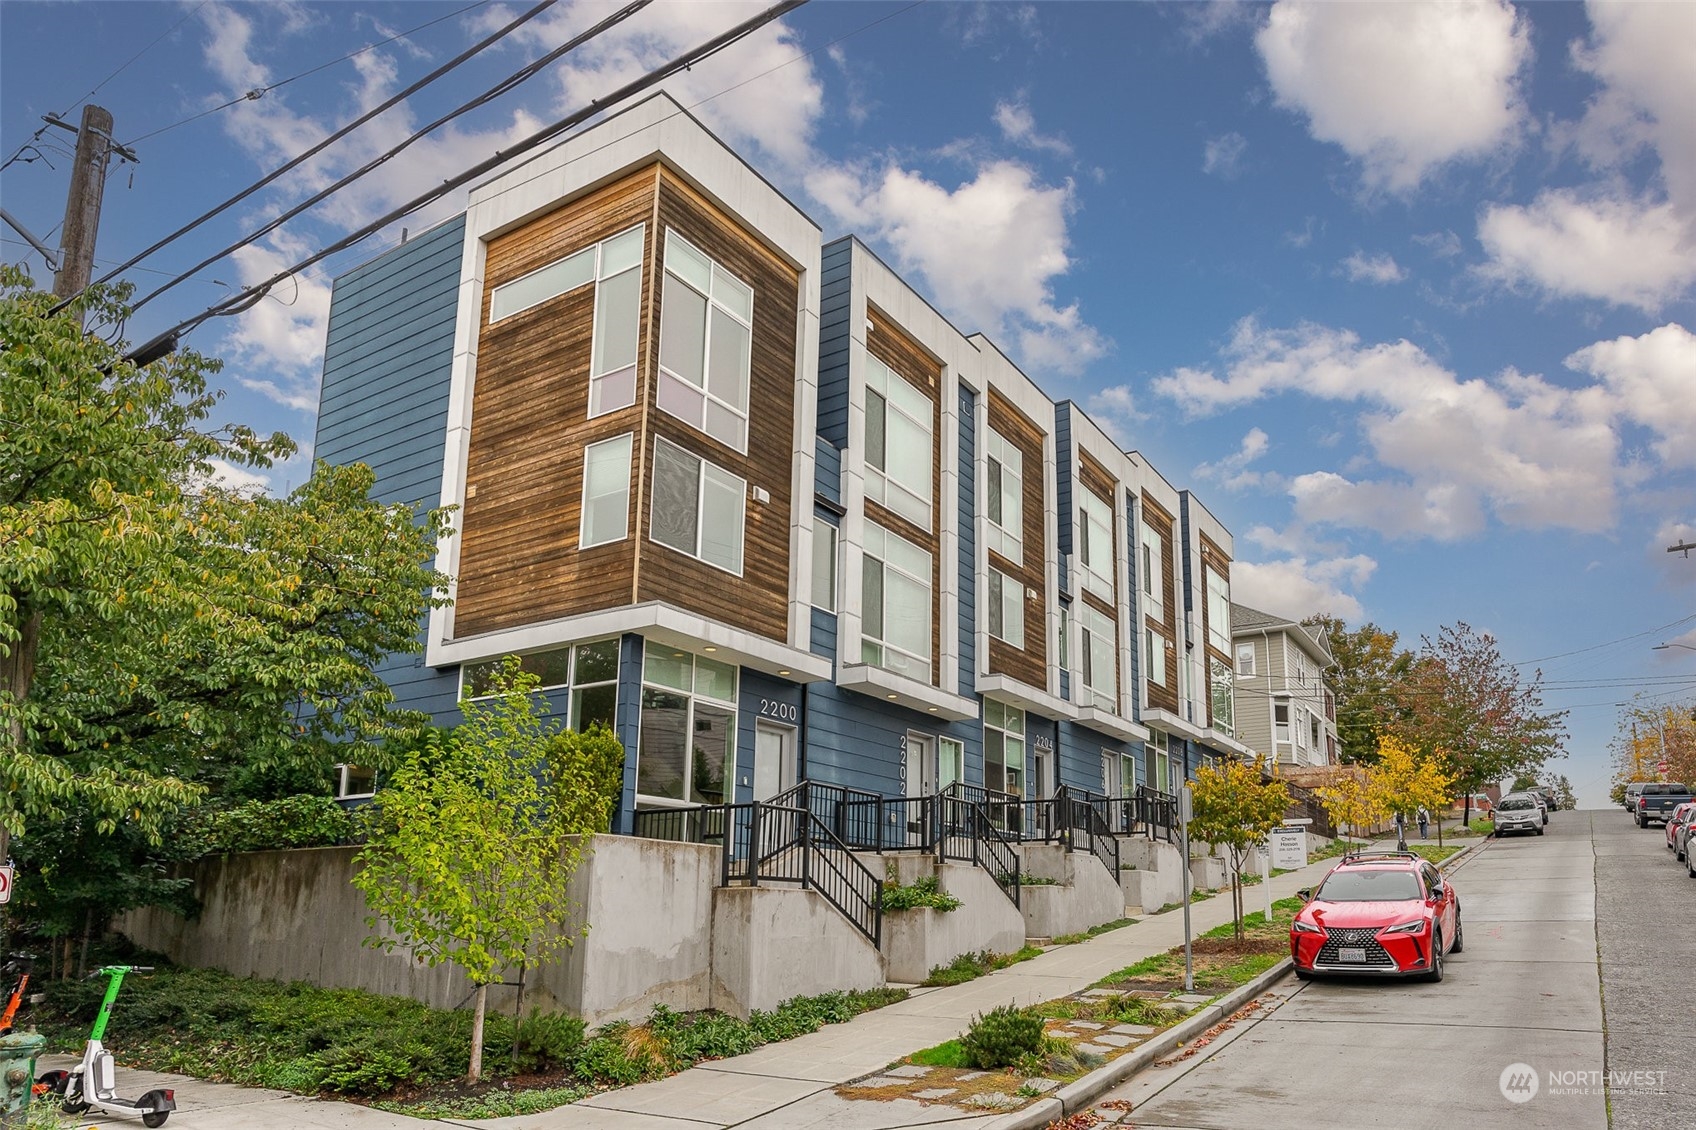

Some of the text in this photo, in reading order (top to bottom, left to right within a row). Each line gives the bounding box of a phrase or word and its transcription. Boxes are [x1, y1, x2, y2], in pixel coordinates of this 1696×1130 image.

[760, 698, 797, 721] 2200
[1035, 734, 1053, 750] 2204
[899, 735, 907, 795] 2202
